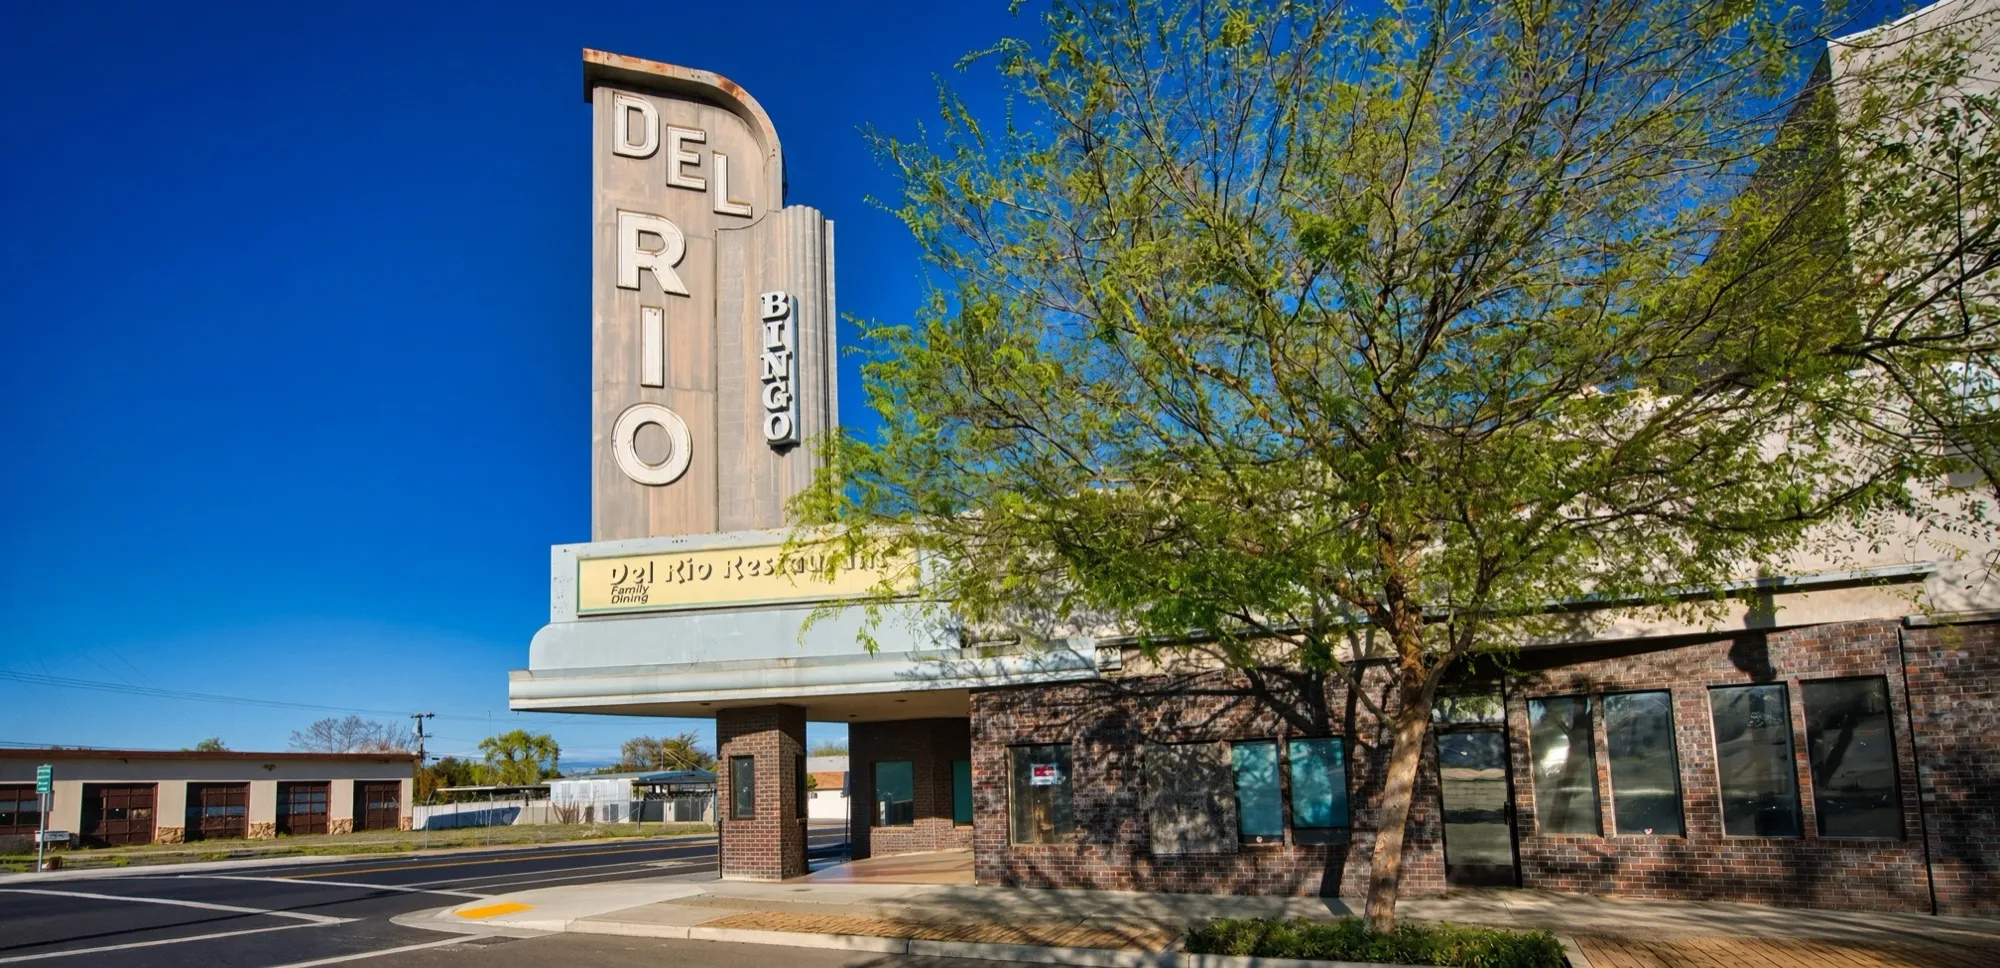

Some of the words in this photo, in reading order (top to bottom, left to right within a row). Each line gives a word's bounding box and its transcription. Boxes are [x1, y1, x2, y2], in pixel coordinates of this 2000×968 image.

[613, 91, 753, 218] DEL
[611, 208, 693, 486] RIO
[761, 290, 793, 443] BINGO
[610, 560, 654, 585] Del
[665, 557, 713, 584] Rio
[723, 549, 889, 581] Resauant
[611, 584, 650, 596] Family
[611, 594, 649, 605] Dining
